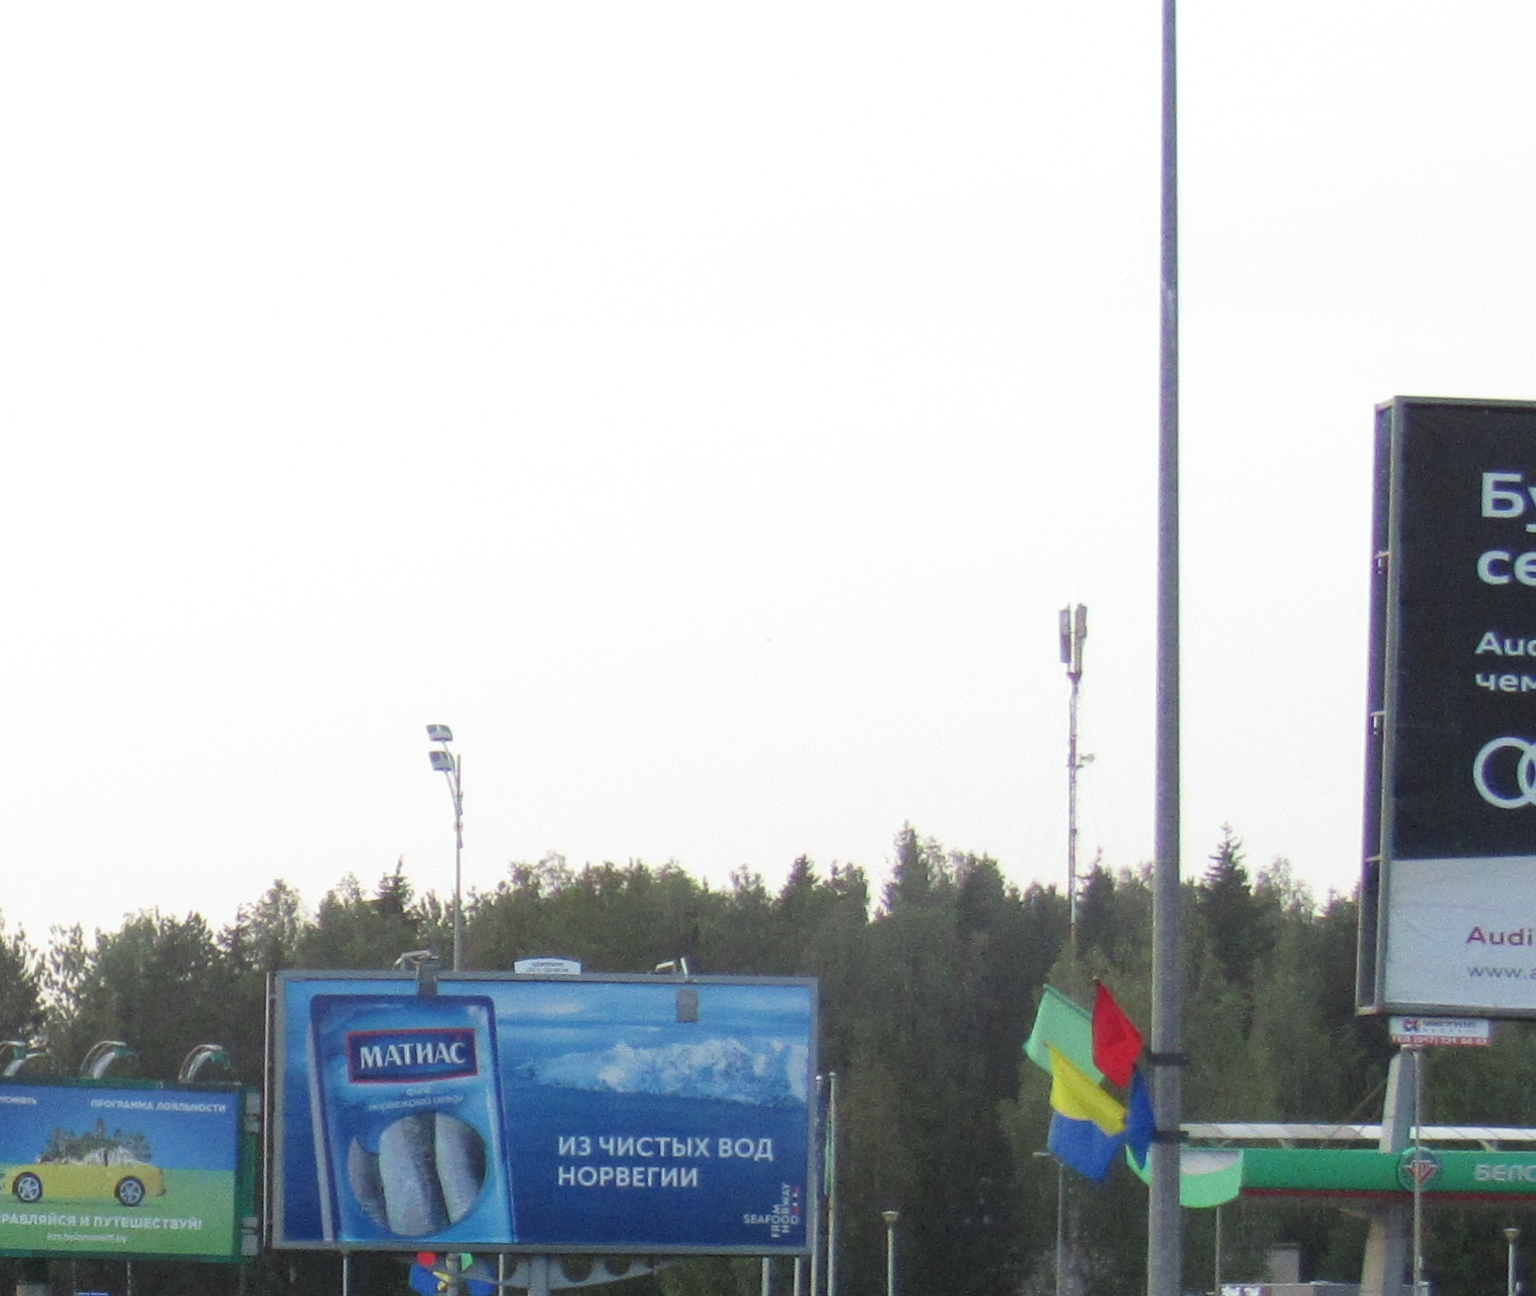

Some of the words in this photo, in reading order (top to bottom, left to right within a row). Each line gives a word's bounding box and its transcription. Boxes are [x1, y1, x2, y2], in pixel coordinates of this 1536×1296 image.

[1481, 471, 1536, 533] Б
[1466, 926, 1533, 946] Audi
[359, 1041, 467, 1070] МАТИАС
[90, 1098, 153, 1111] ПРОГРАММА
[155, 1100, 227, 1113] ЛОЯЛЬНОСТИ
[558, 1136, 591, 1157] ИЗ
[599, 1136, 710, 1158] ЧИСТЫХ
[717, 1137, 774, 1162] ВОД
[557, 1166, 699, 1188] НОРВЕГИИ
[79, 1215, 91, 1227] И
[93, 1213, 203, 1231] ПУТЕШЕСТВУЙ!
[743, 1213, 800, 1226] SEAFOOD
